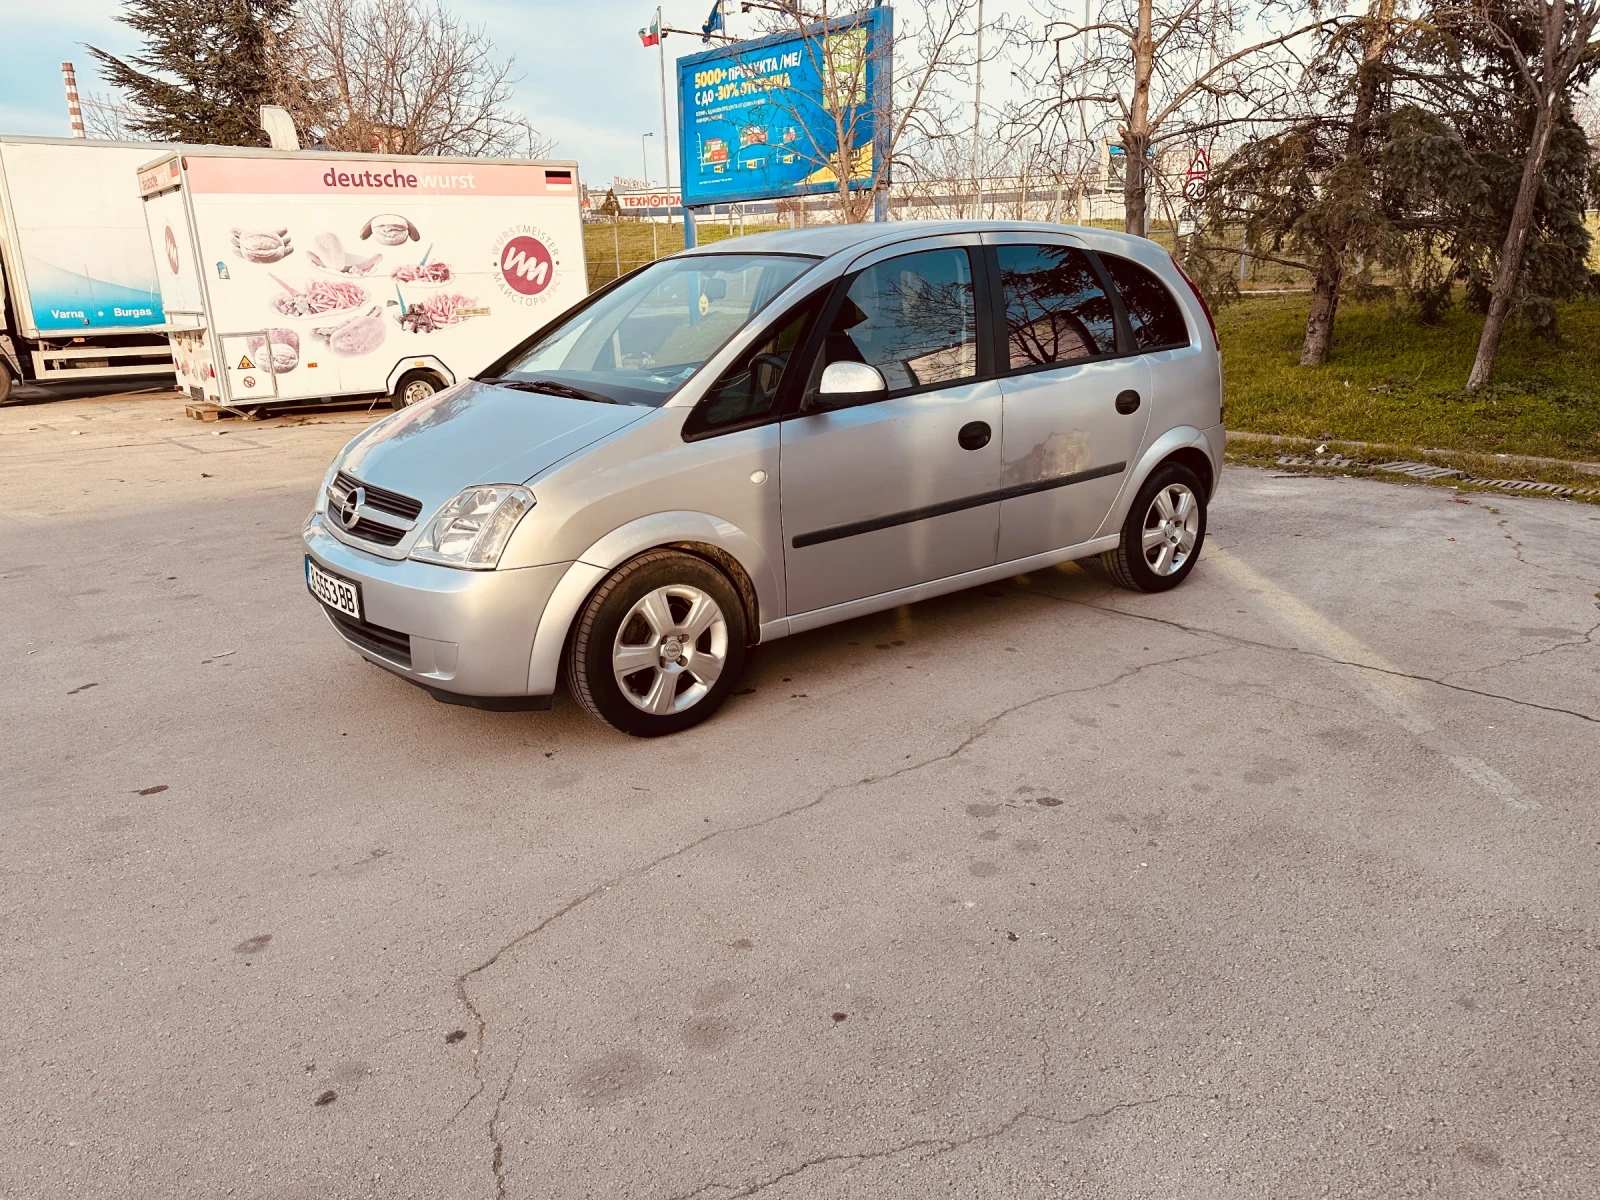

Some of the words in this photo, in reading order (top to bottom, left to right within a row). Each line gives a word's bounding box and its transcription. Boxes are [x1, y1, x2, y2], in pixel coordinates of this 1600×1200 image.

[695, 68, 727, 89] 5000+
[701, 89, 714, 106] ДО
[1188, 182, 1205, 197] 20
[51, 310, 84, 319] Varna
[113, 307, 153, 318] Burgas
